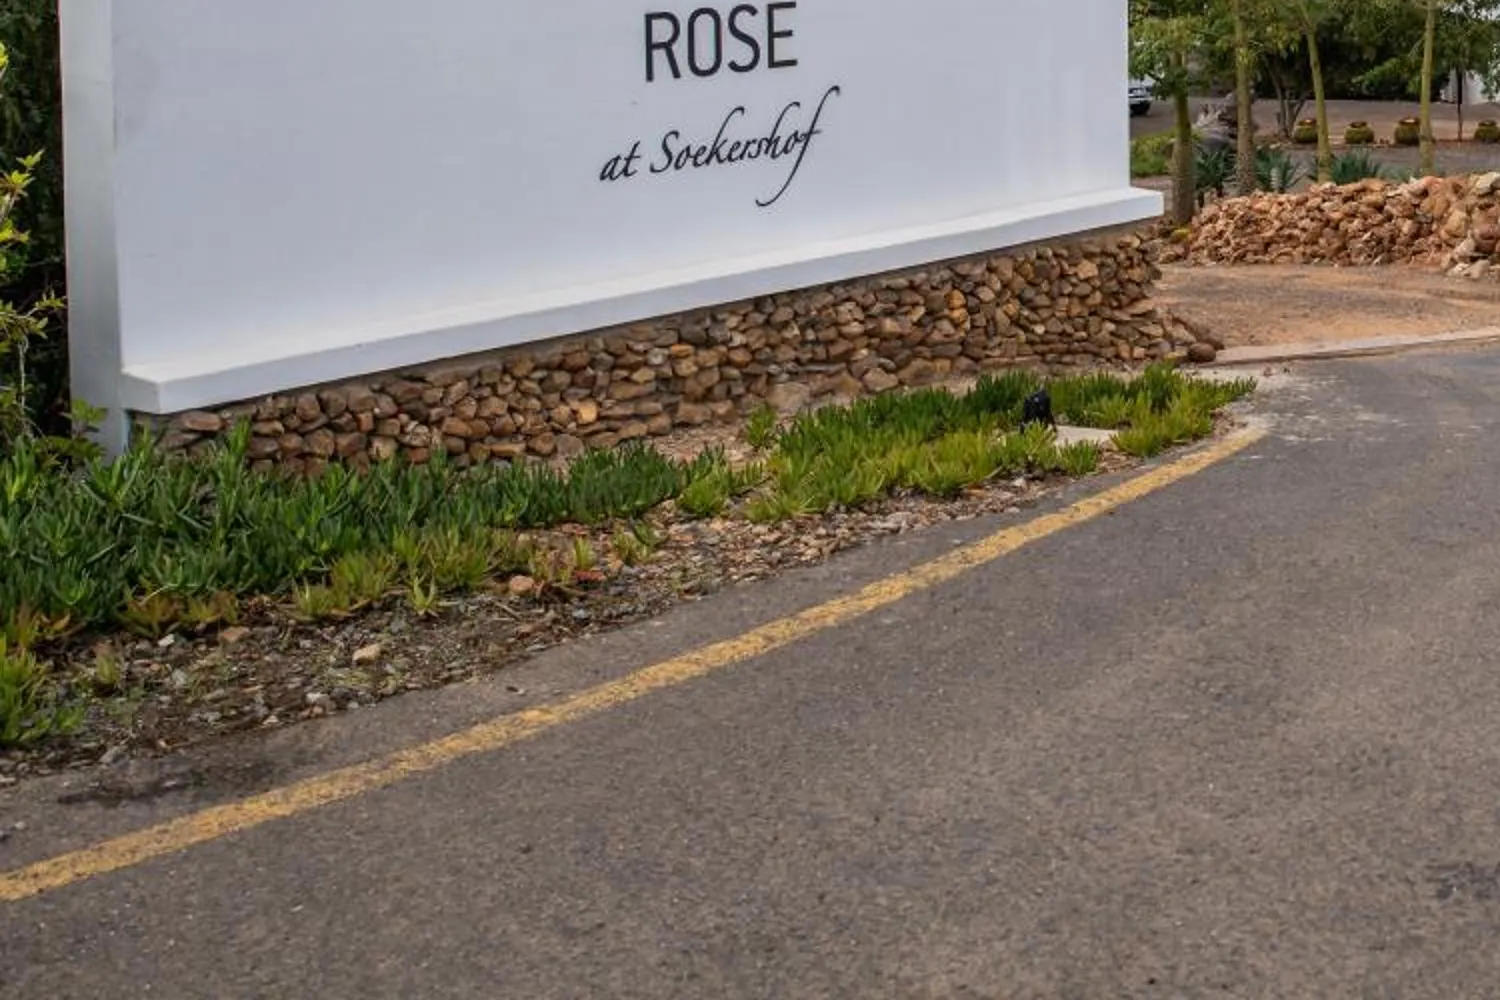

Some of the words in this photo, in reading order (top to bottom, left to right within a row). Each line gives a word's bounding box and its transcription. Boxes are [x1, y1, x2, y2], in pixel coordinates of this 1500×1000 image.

[643, 1, 799, 82] ROSE
[599, 140, 641, 182] at
[649, 84, 841, 208] Soekershof
